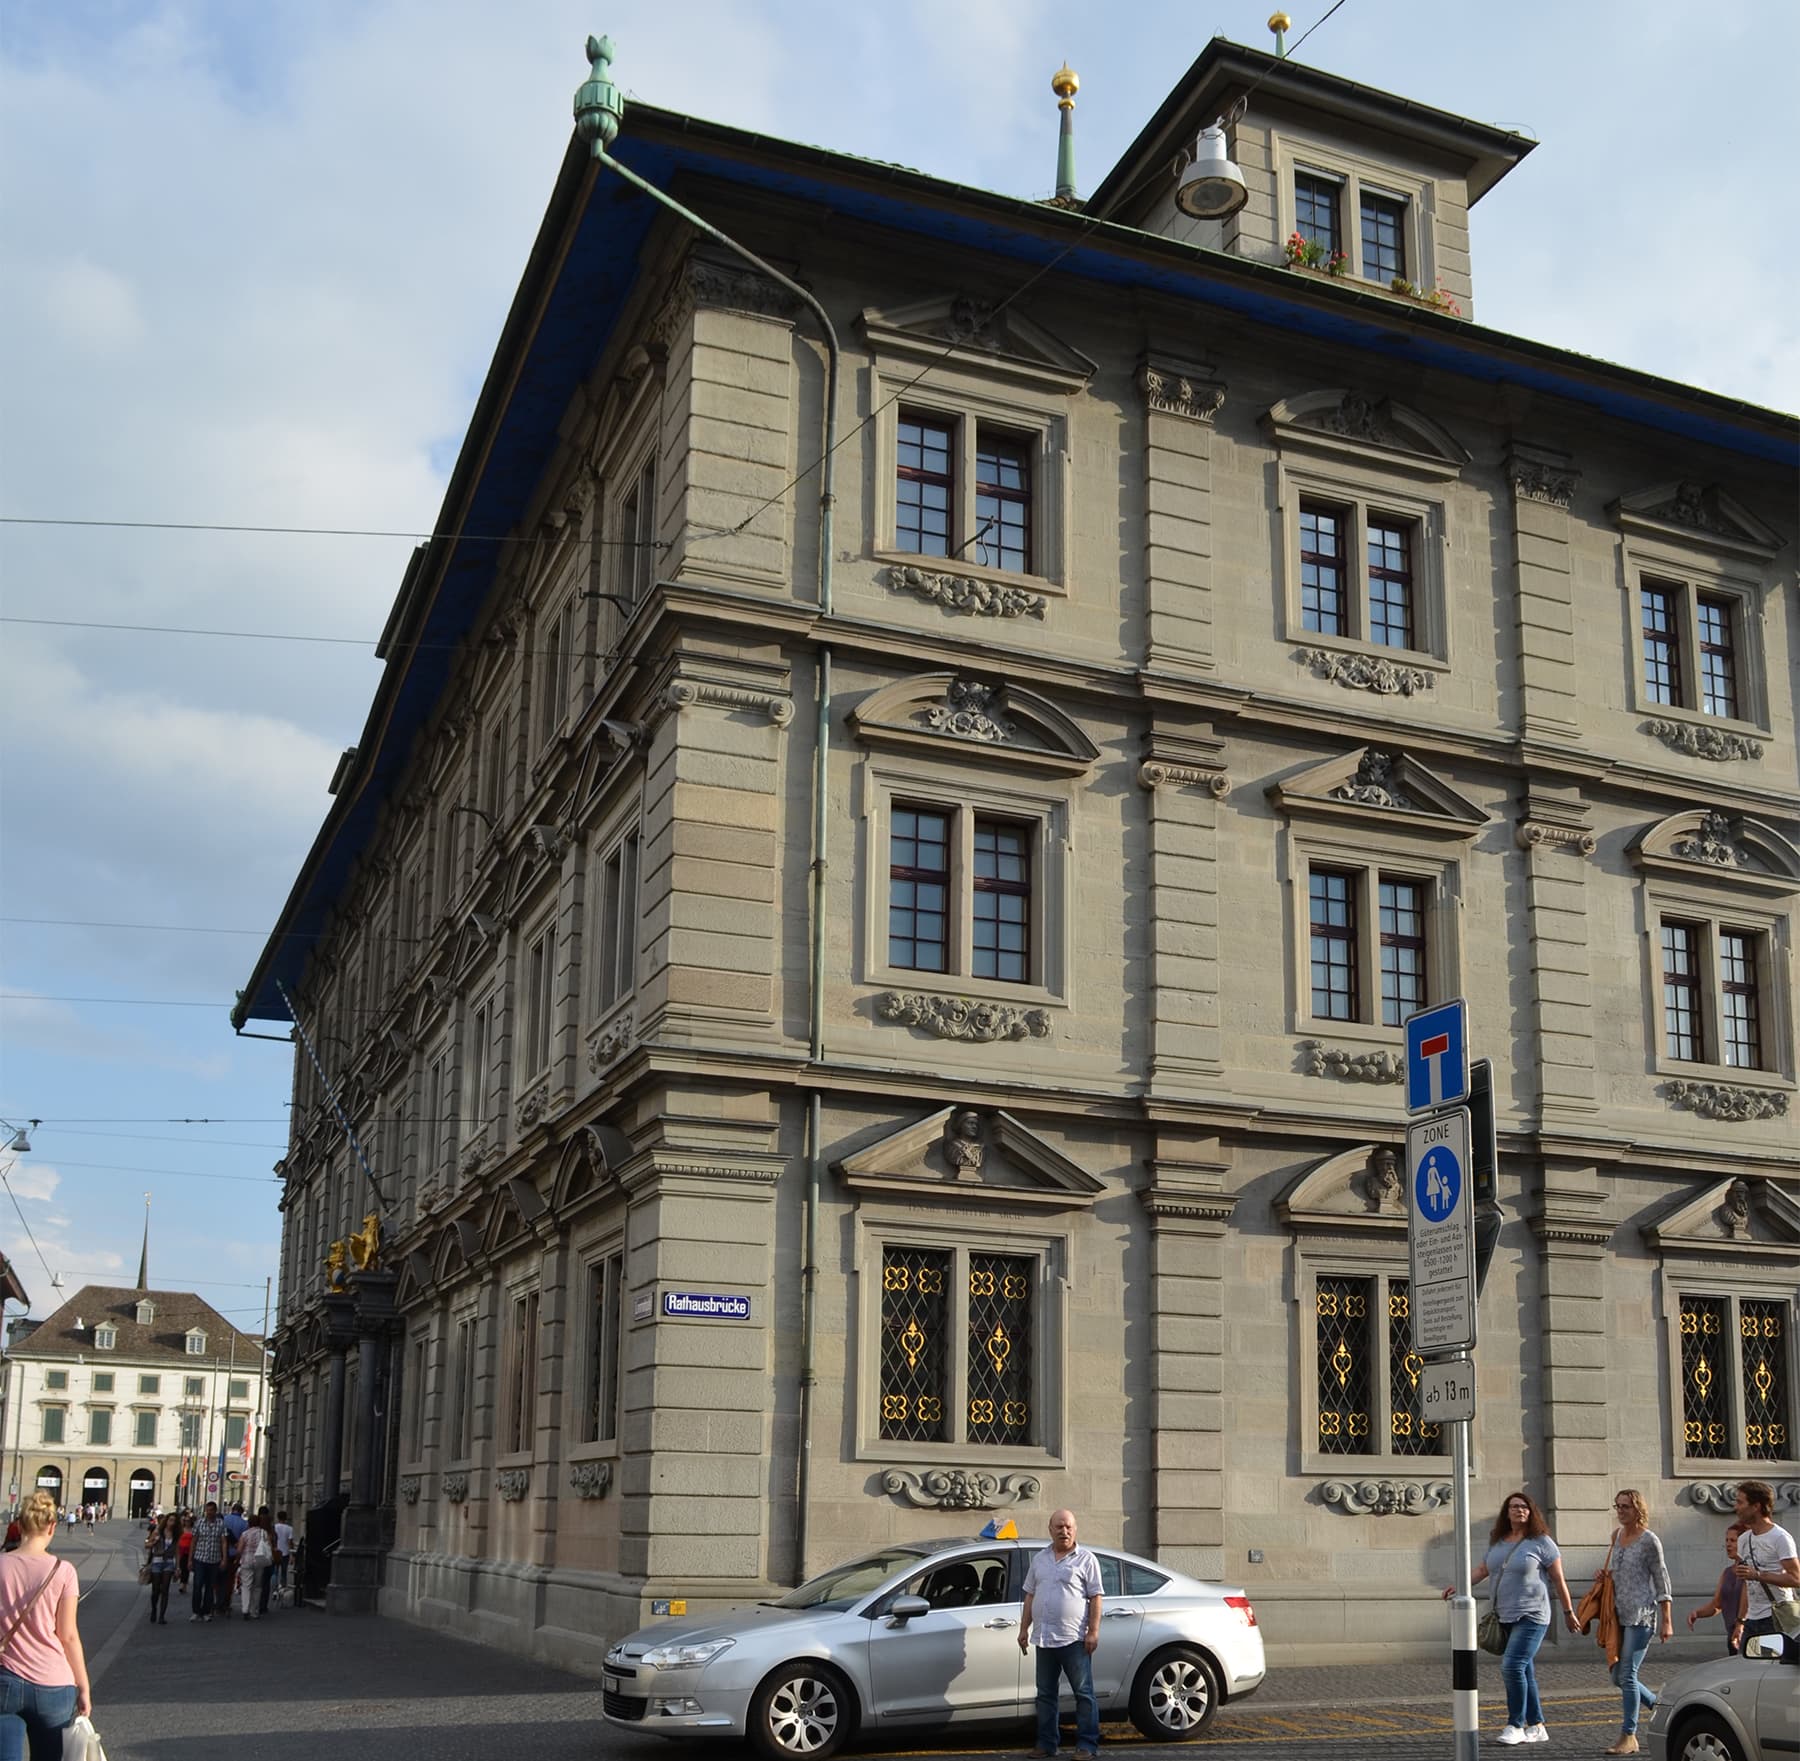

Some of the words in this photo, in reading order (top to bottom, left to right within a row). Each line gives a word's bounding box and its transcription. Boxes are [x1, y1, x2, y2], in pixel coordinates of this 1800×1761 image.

[1423, 1124, 1449, 1144] ZONE
[668, 1294, 747, 1314] Rathausbrücke
[1426, 1385, 1440, 1403] ab
[1445, 1380, 1456, 1401] 13
[1459, 1386, 1470, 1400] m
